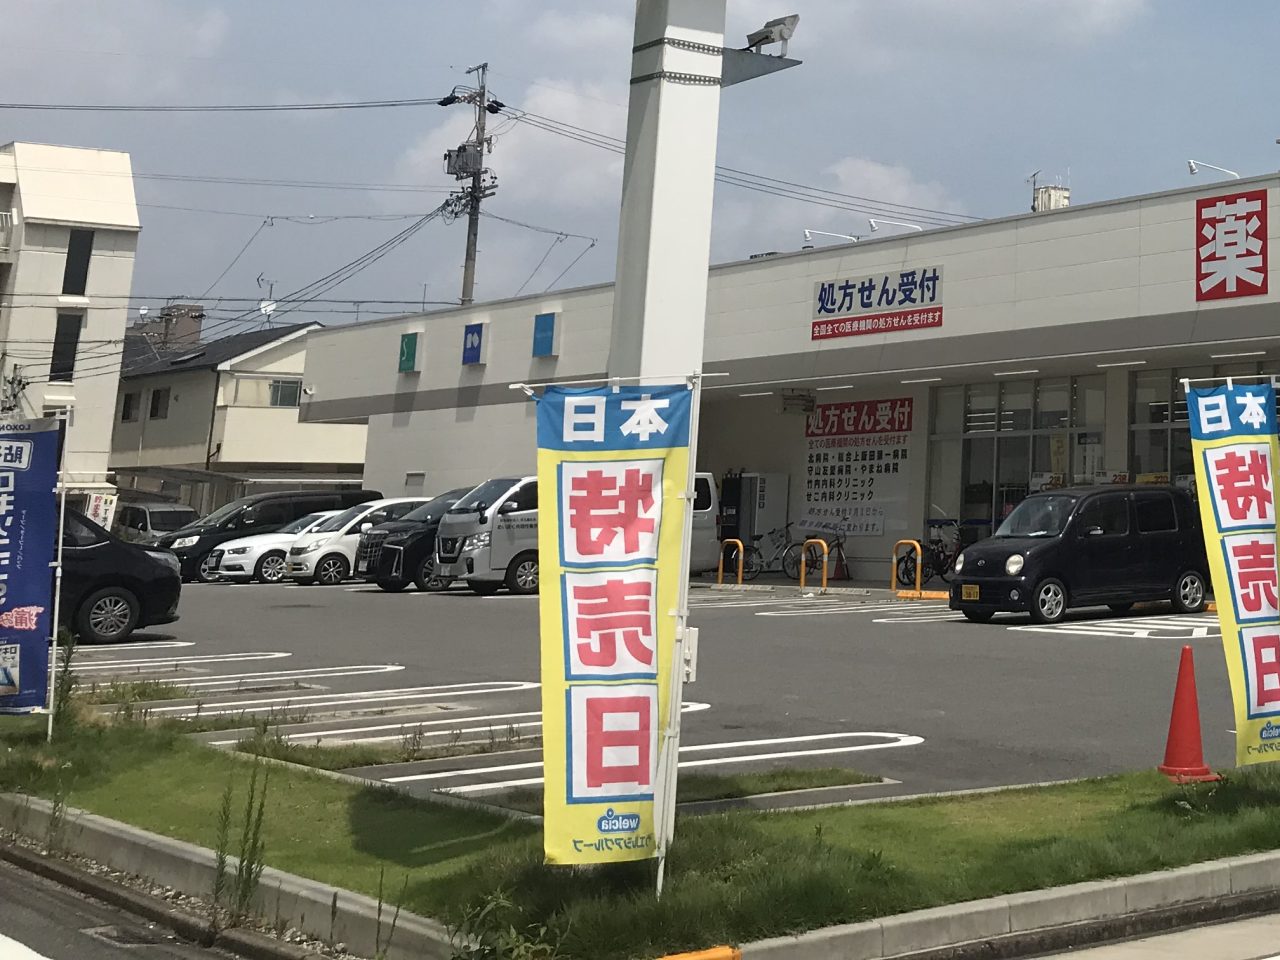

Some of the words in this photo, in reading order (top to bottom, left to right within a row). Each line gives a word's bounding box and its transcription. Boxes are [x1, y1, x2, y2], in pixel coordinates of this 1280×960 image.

[1199, 197, 1265, 293] 薬
[817, 268, 940, 314] 処方せん受付
[808, 401, 911, 434] 処方せん受付
